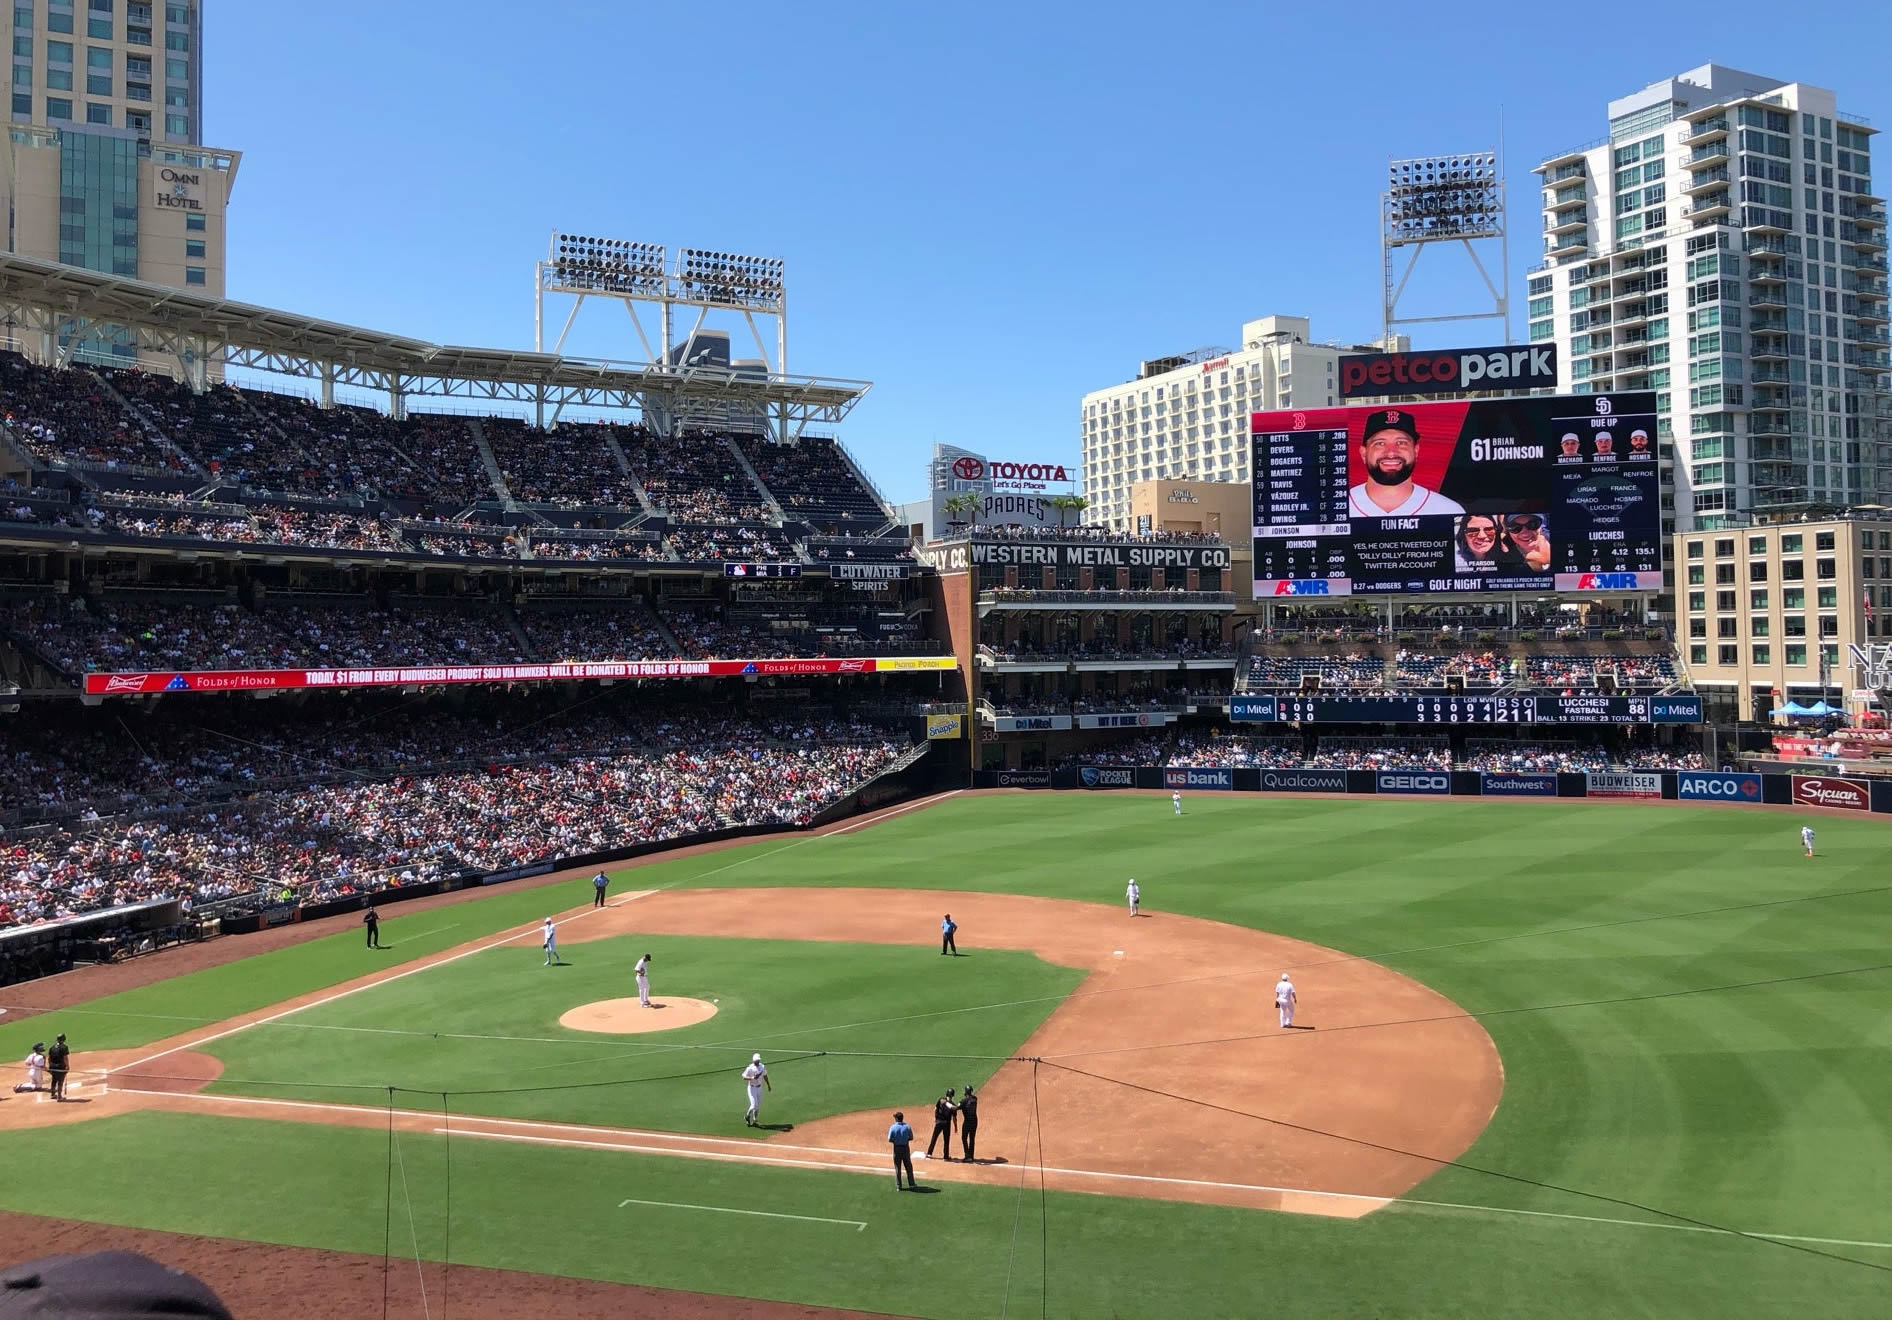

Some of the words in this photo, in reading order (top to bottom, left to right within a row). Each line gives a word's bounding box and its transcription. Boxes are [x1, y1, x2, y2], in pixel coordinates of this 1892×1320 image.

[161, 168, 199, 185] OMNI
[157, 192, 203, 210] HOTEL
[1591, 419, 1605, 428] DUE
[1607, 418, 1618, 427] UP
[1270, 434, 1289, 442] BETTS
[1492, 437, 1514, 446] BRIAN
[1270, 446, 1294, 454] DEVERS
[1332, 444, 1346, 452] .328
[1471, 438, 1490, 461] 61
[1492, 445, 1544, 460] JOHNSON
[1270, 457, 1303, 466] BOGAERTS
[990, 462, 1068, 481] TOYOTA
[1270, 468, 1302, 477] MARTINEZ
[1333, 466, 1346, 474] .312
[1624, 470, 1654, 478] RENFROE
[1022, 482, 1046, 490] Places
[1271, 480, 1293, 489] TRAVIS
[1333, 479, 1347, 487] .255
[1333, 490, 1347, 498] .284
[984, 496, 1045, 521] PADRES
[1271, 504, 1299, 512] BRADLEY
[1333, 502, 1347, 510] .223
[1271, 516, 1296, 524] OWINGS
[1381, 519, 1396, 530] FUN
[1398, 518, 1420, 529] FACT
[1272, 527, 1300, 535] JOHNSON
[1588, 531, 1624, 540] LUCCHESI
[1286, 540, 1317, 549] JOHNSON
[1368, 542, 1378, 550] HE
[1433, 540, 1448, 548] OUT
[972, 546, 1058, 564] WESTERN
[1066, 547, 1124, 565] METAL
[1130, 549, 1193, 566] SUPPLY
[1202, 551, 1228, 567] CO.
[1612, 548, 1628, 556] 4.12
[951, 548, 968, 568] CO.
[840, 566, 900, 578] CUTWATER
[1614, 564, 1626, 572] 45
[852, 581, 888, 590] SPIRITS
[1376, 582, 1402, 590] DODGERS
[1430, 580, 1452, 590] GOLF
[1454, 578, 1482, 590] NIGHT
[764, 664, 788, 672] FOLDS
[790, 663, 797, 672] of
[798, 663, 826, 671] HONOR
[306, 672, 336, 685] TODAY,
[336, 672, 348, 684] $1
[349, 671, 372, 683] FROM
[374, 670, 400, 682] EVERY
[400, 669, 446, 682] BUDWEISER
[448, 668, 482, 680] PRODUCT
[483, 667, 500, 679] SOLD
[503, 667, 514, 678] VIA
[516, 666, 548, 678] HAWKERS
[550, 666, 572, 676] WILL
[573, 665, 584, 676] BE
[586, 664, 626, 676] DONATED
[627, 664, 638, 675] TO
[640, 664, 666, 674] FOLDS
[668, 663, 679, 674] OF
[680, 663, 710, 674] HONOR
[198, 676, 228, 687] FOLDS
[230, 675, 240, 687] of
[241, 674, 276, 686] HONOR
[1498, 698, 1506, 708] B
[1511, 698, 1520, 708] S
[1558, 698, 1608, 707] LUCCHESI
[1247, 704, 1272, 714] Mitel
[1629, 705, 1644, 714] 88
[1669, 705, 1697, 716] Mitel
[1498, 709, 1508, 722] 2
[1511, 709, 1519, 722] 1
[1524, 709, 1532, 722] 1
[930, 721, 958, 736] Snapple
[1028, 718, 1052, 730] Mitel
[1011, 774, 1049, 784] everbowl
[1100, 770, 1132, 778] ROCKET
[1264, 773, 1344, 789] Qualcomm
[1380, 776, 1448, 789] GEICO
[1486, 779, 1544, 790] Southwest
[1592, 776, 1655, 788] BUDWEISER
[1681, 779, 1738, 796] ARCO
[1800, 781, 1860, 803] Sycuan
